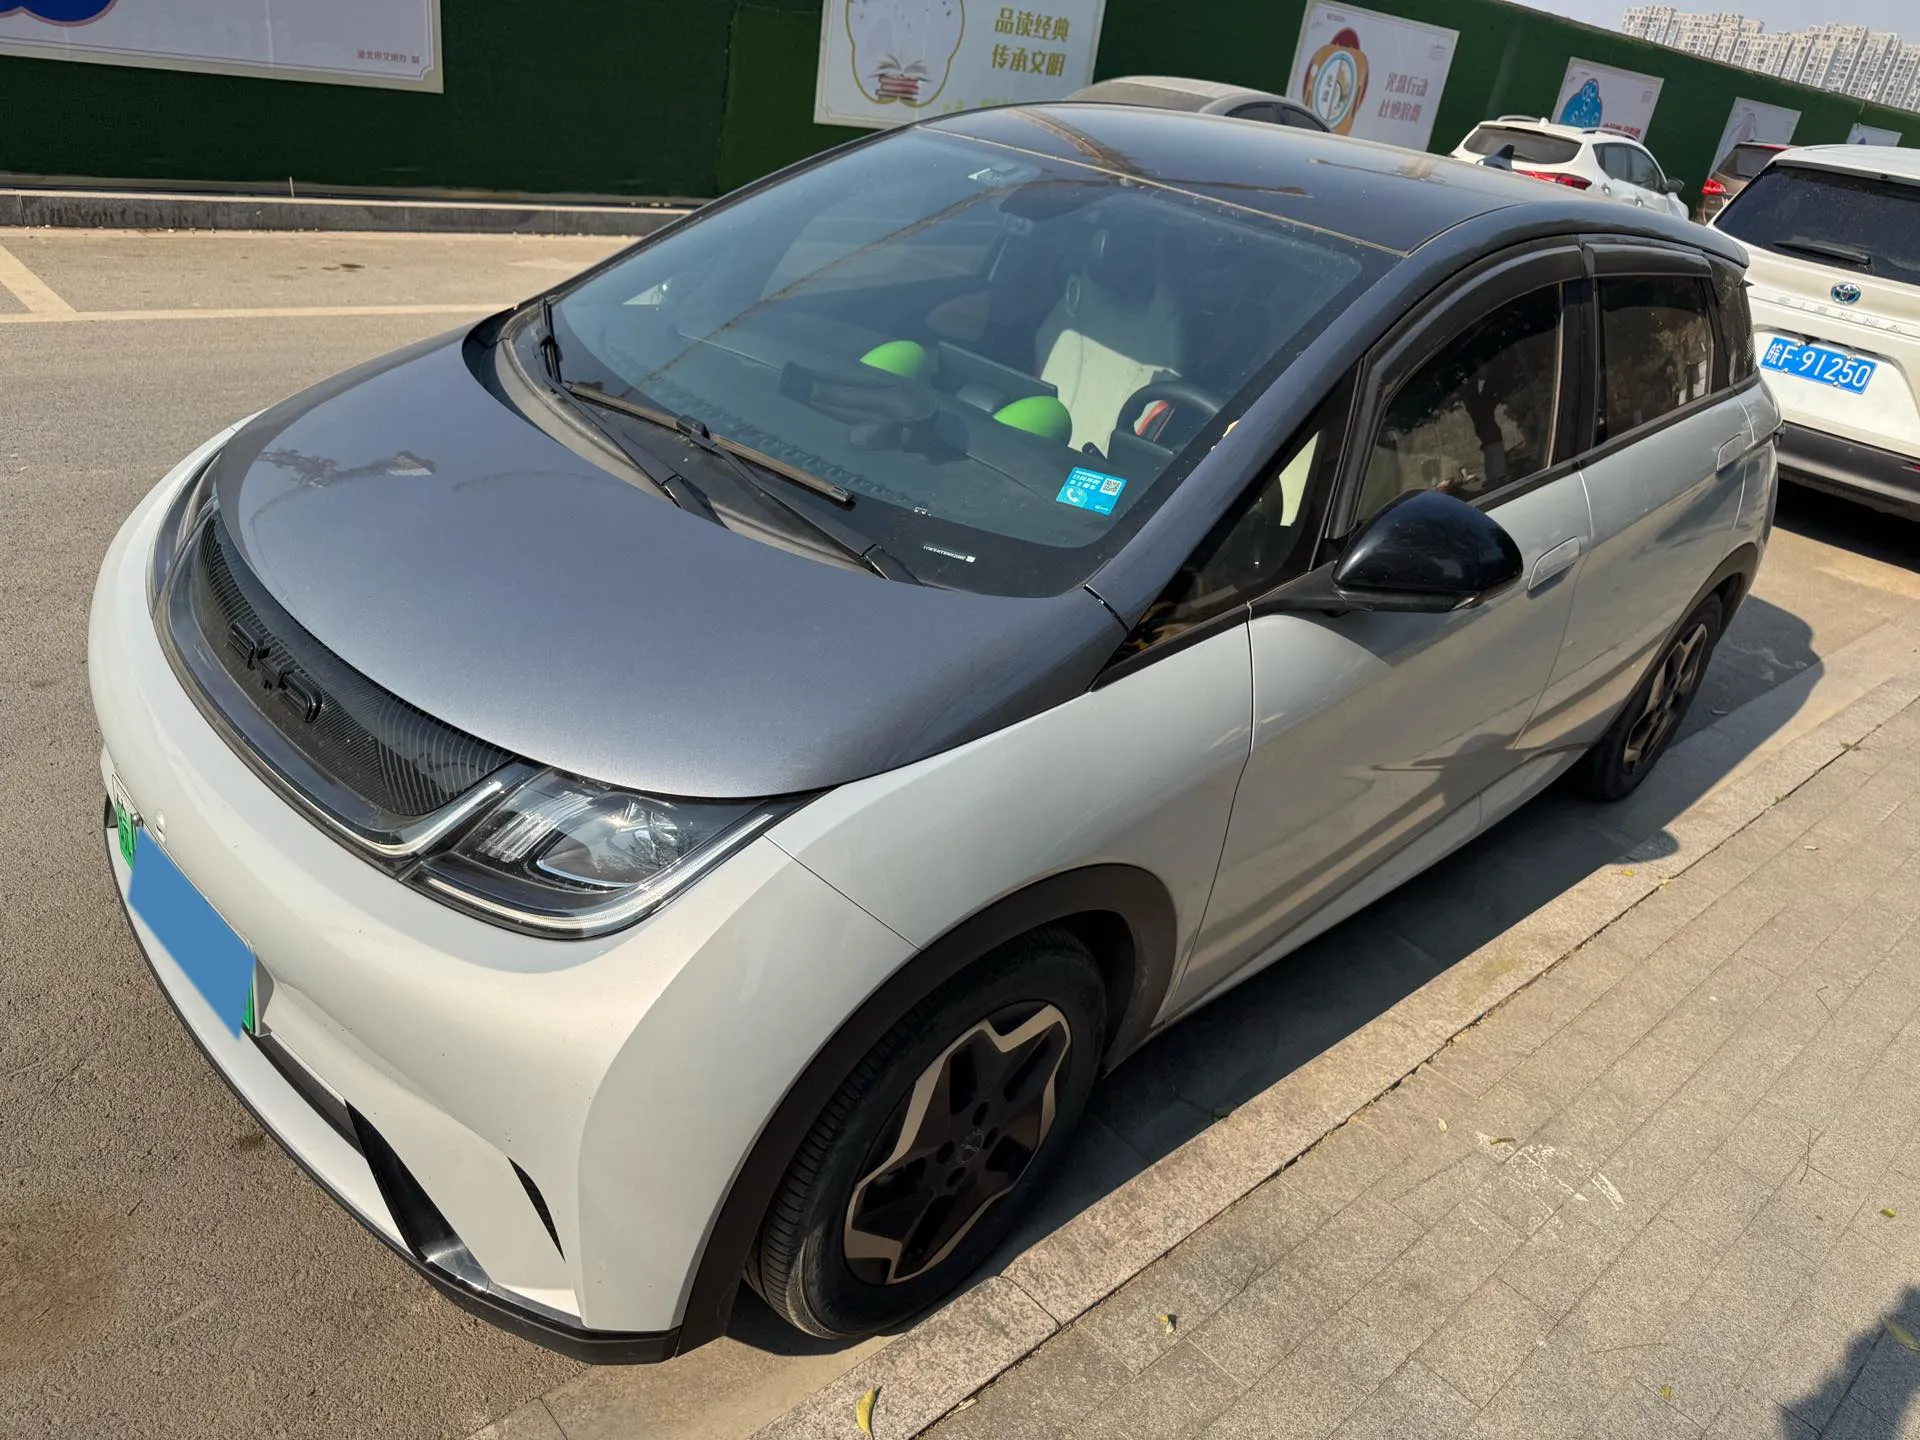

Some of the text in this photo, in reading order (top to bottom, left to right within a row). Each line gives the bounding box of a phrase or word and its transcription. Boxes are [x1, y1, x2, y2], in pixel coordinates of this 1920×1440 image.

[995, 7, 1070, 43] 品读经典
[991, 44, 1067, 77] 传承文明
[1777, 296, 1902, 334] SIENNA
